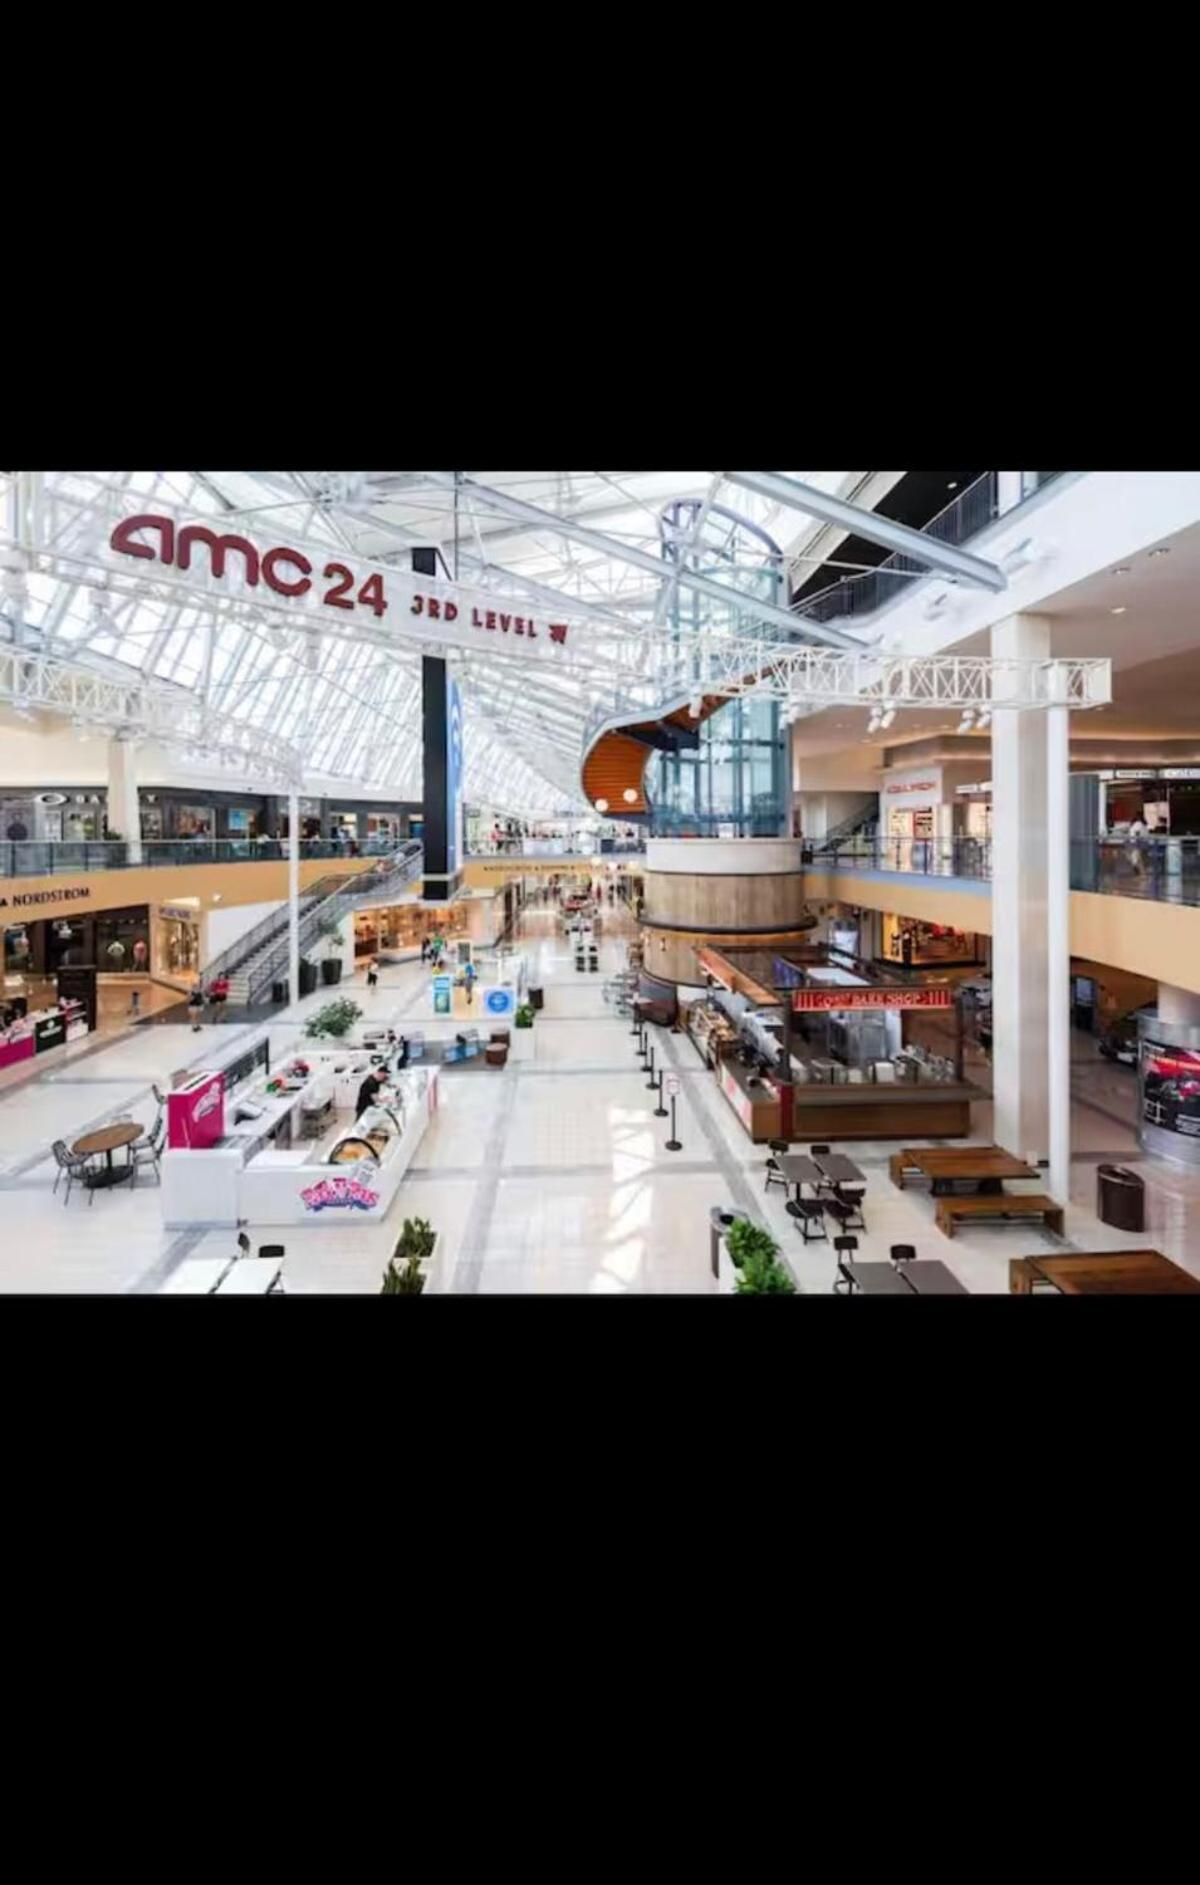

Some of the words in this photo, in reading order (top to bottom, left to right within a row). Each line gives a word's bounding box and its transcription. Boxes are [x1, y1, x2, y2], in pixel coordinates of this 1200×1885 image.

[323, 562, 388, 617] 24
[410, 594, 458, 621] 3RD
[471, 606, 537, 638] LEVEL
[12, 887, 91, 907] NORDSTROM
